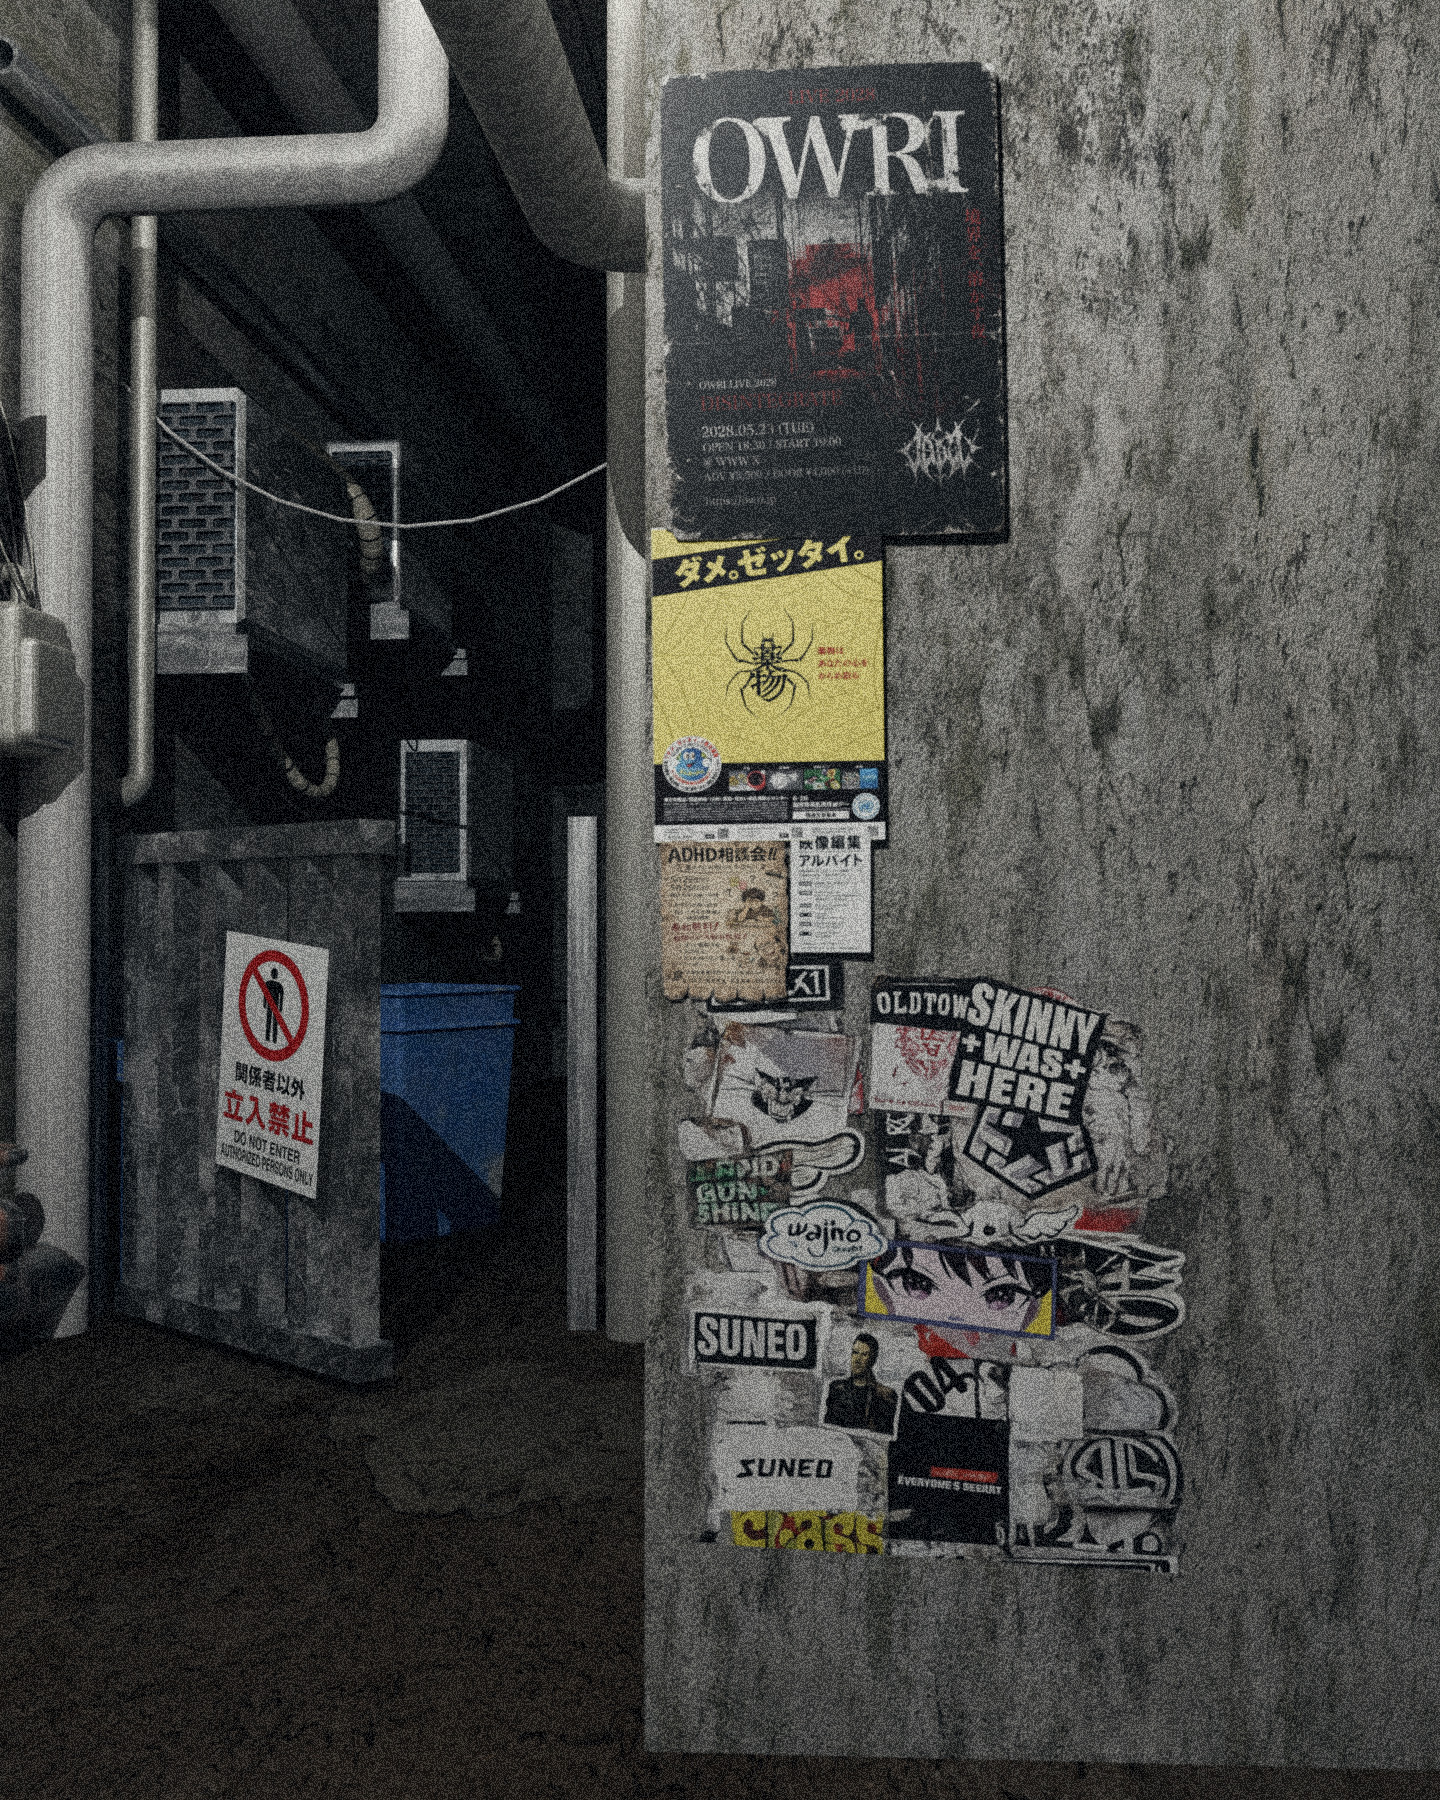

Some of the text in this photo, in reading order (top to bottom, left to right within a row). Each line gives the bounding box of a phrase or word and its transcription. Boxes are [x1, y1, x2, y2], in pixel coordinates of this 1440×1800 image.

[692, 110, 969, 203] OWRI
[700, 389, 844, 412] DISINTEGRATE
[675, 535, 866, 588] ダメ。ゼッタイ。
[798, 853, 864, 868] アルバイト
[966, 982, 1101, 1057] SKINNY
[235, 1061, 306, 1101] 関係者以外
[954, 1058, 1077, 1119] HERE
[223, 1089, 314, 1146] 立入禁止
[233, 1129, 301, 1164] DO NOT ENTER
[262, 1156, 294, 1180] PERSONS
[294, 1168, 314, 1186] ONLY
[696, 1315, 808, 1361] SUNEO
[736, 1457, 833, 1478] SUNEO
